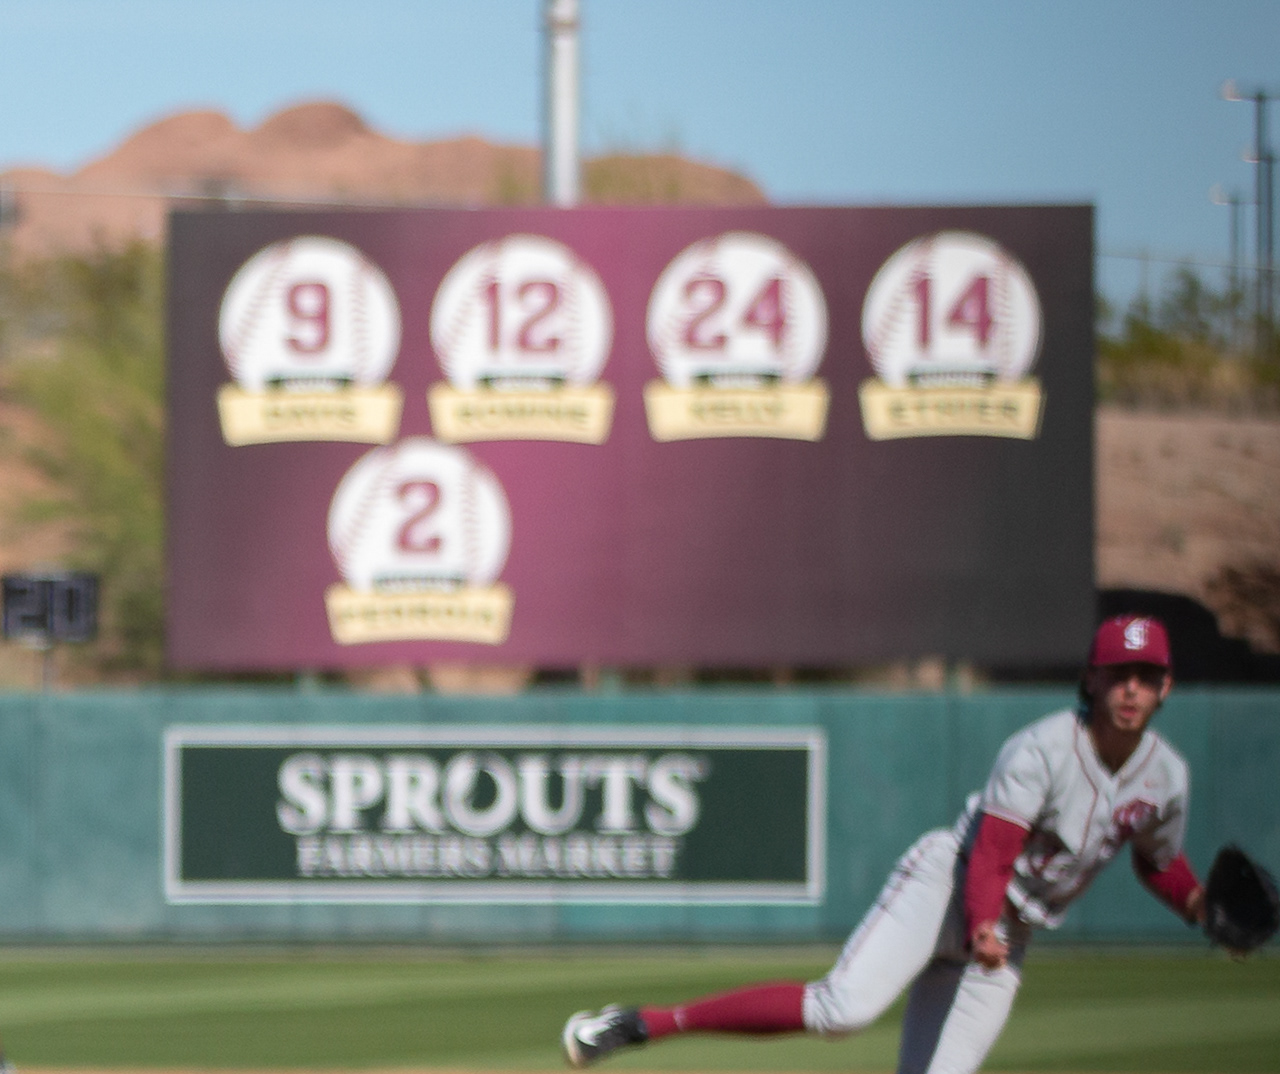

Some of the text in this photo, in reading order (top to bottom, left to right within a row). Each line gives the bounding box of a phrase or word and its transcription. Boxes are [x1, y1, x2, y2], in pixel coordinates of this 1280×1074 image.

[284, 280, 333, 355] 9
[480, 280, 562, 356] 12
[680, 276, 789, 354] 24
[910, 273, 997, 353] 14
[394, 480, 443, 557] 2
[276, 751, 702, 838] SPROUTS
[296, 835, 678, 878] FARMERS MARKET
